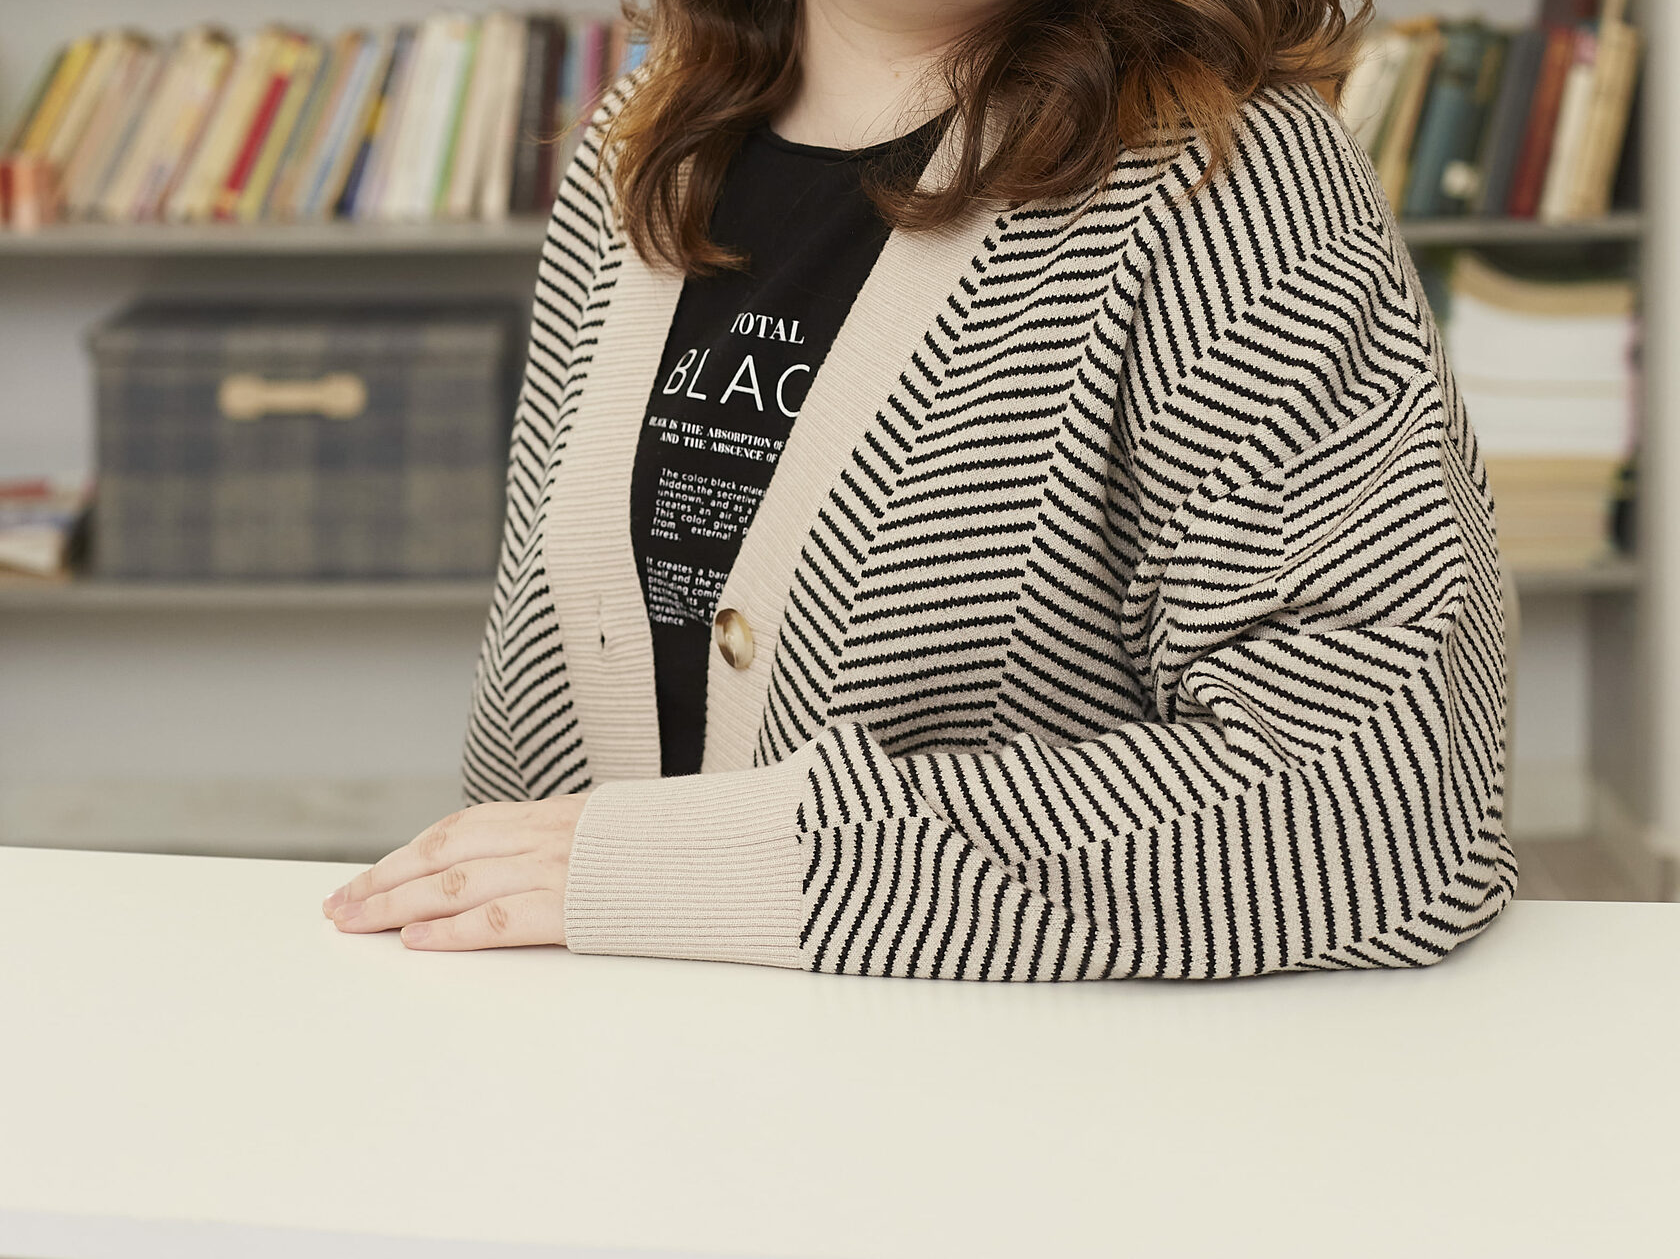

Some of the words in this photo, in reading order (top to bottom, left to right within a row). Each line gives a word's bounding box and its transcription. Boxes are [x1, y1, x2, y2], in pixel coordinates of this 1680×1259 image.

[669, 419, 678, 430] IS
[681, 422, 704, 436] THE
[707, 427, 772, 449] ABSORPTION
[773, 440, 785, 451] OF
[660, 431, 680, 444] AND
[683, 436, 707, 450] THE
[710, 441, 764, 461] ABSCENCE
[766, 452, 778, 463] OF
[662, 468, 679, 479] The
[682, 473, 708, 484] color
[710, 477, 736, 490] black
[710, 499, 729, 509] and
[733, 504, 743, 513] as
[717, 490, 757, 505] secretive
[655, 499, 692, 512] creates
[699, 507, 711, 516] an
[719, 510, 732, 520] air
[738, 515, 749, 524] of
[655, 507, 674, 519] This
[681, 514, 706, 525] color
[713, 521, 738, 532] gives
[653, 517, 676, 529] from
[691, 526, 732, 541] external
[657, 560, 693, 574] creates
[672, 573, 691, 584] and
[695, 577, 711, 587] the
